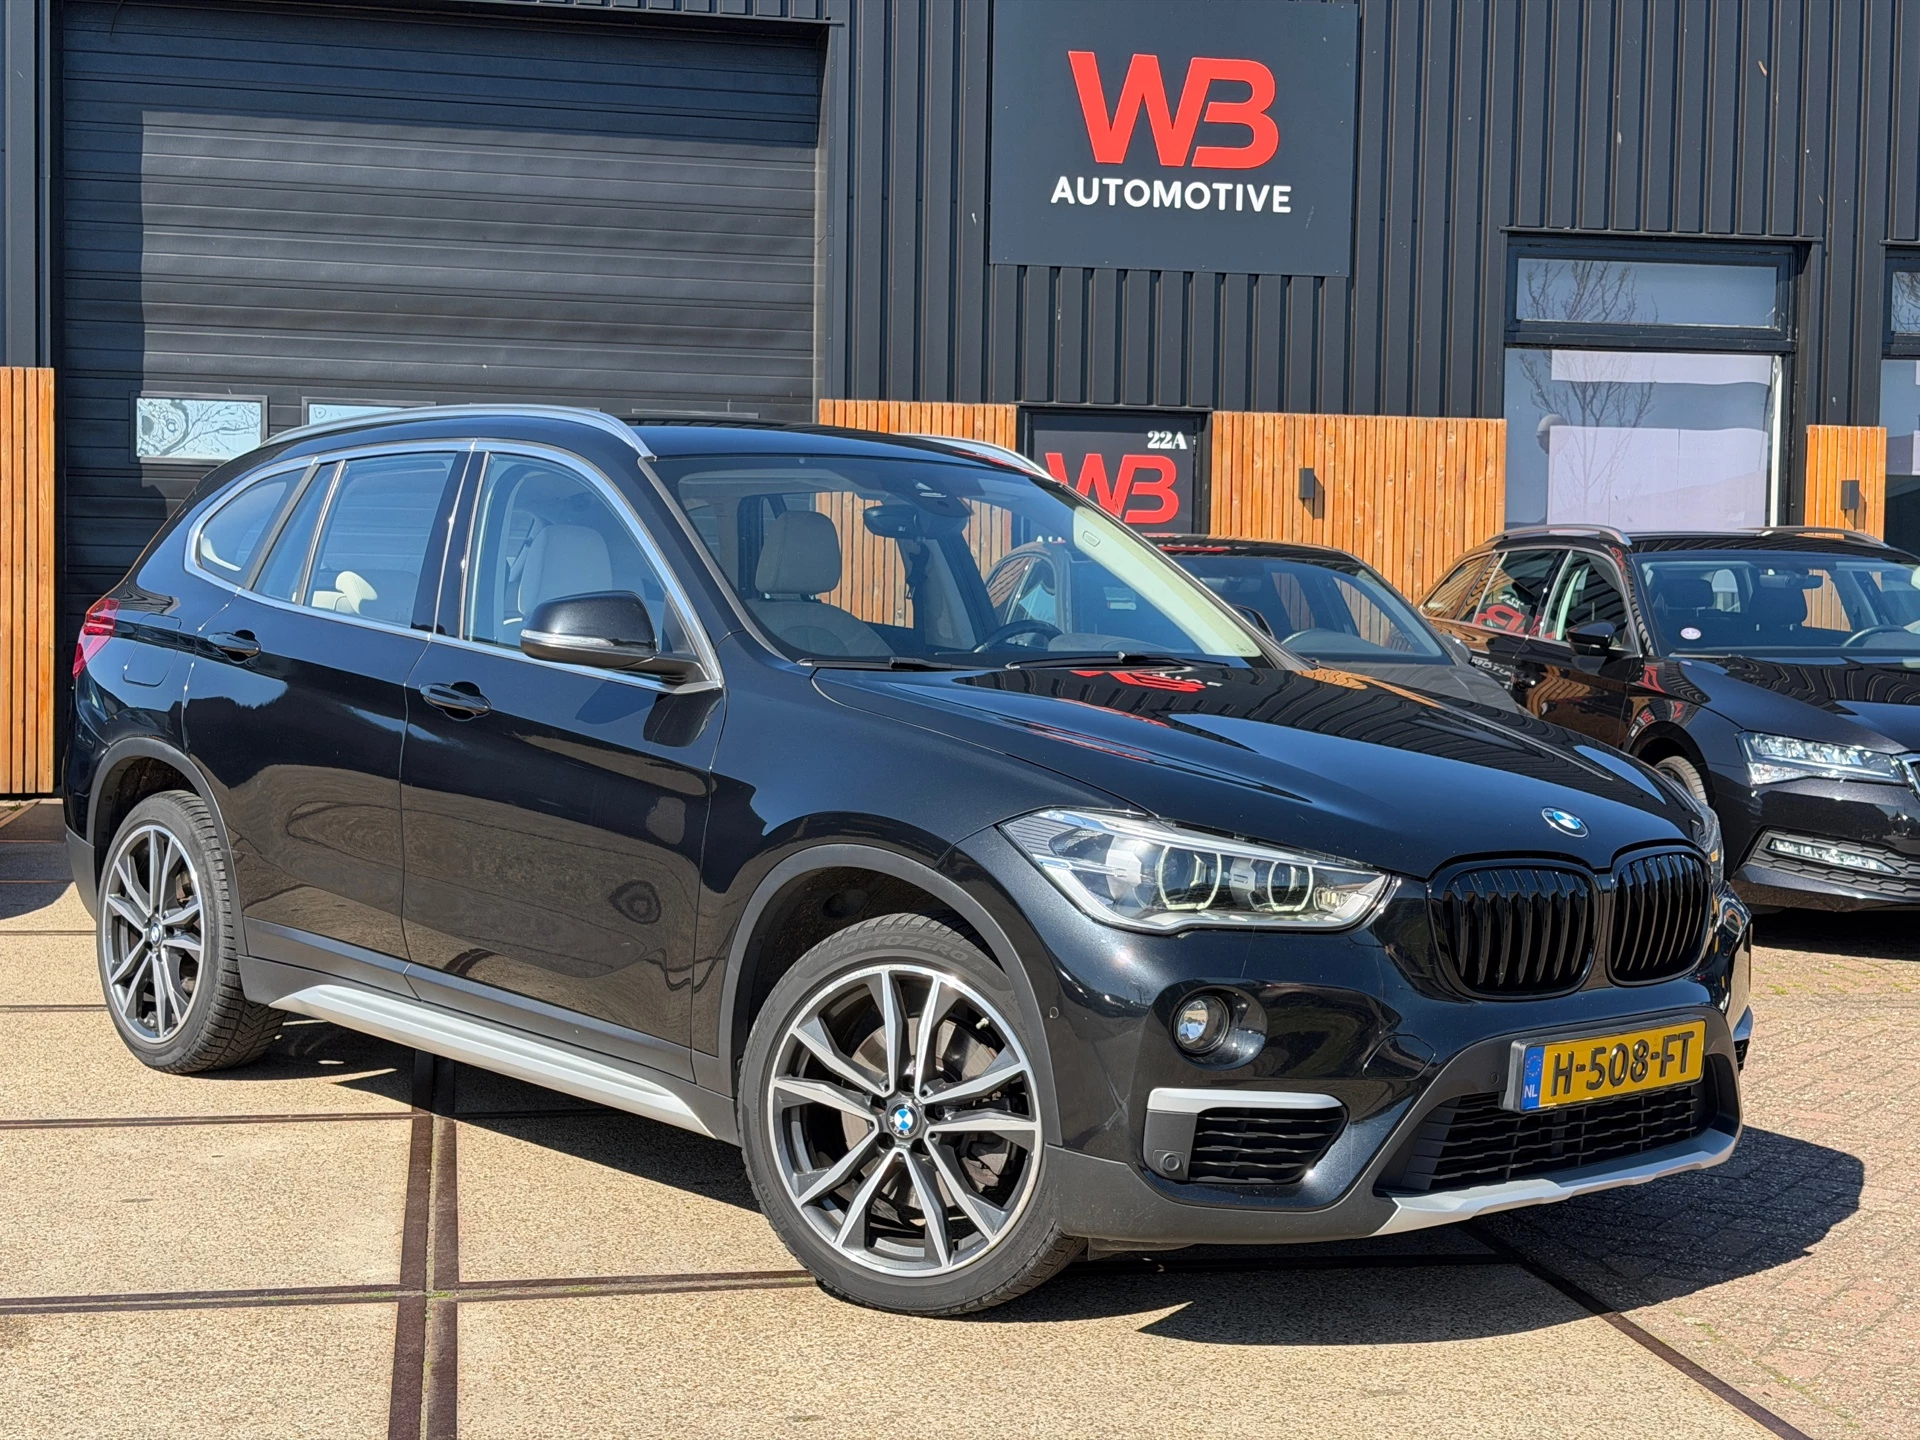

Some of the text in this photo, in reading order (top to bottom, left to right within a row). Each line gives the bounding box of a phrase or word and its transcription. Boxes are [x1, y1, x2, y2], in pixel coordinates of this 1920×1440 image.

[1068, 51, 1280, 169] WB
[1050, 176, 1292, 213] AUTOMOTIVE
[1147, 431, 1187, 449] 22A
[1045, 452, 1180, 524] WB
[831, 935, 969, 962] SOTTOZERO
[1551, 1031, 1694, 1096] H-508-FT
[1524, 1084, 1538, 1098] NL
